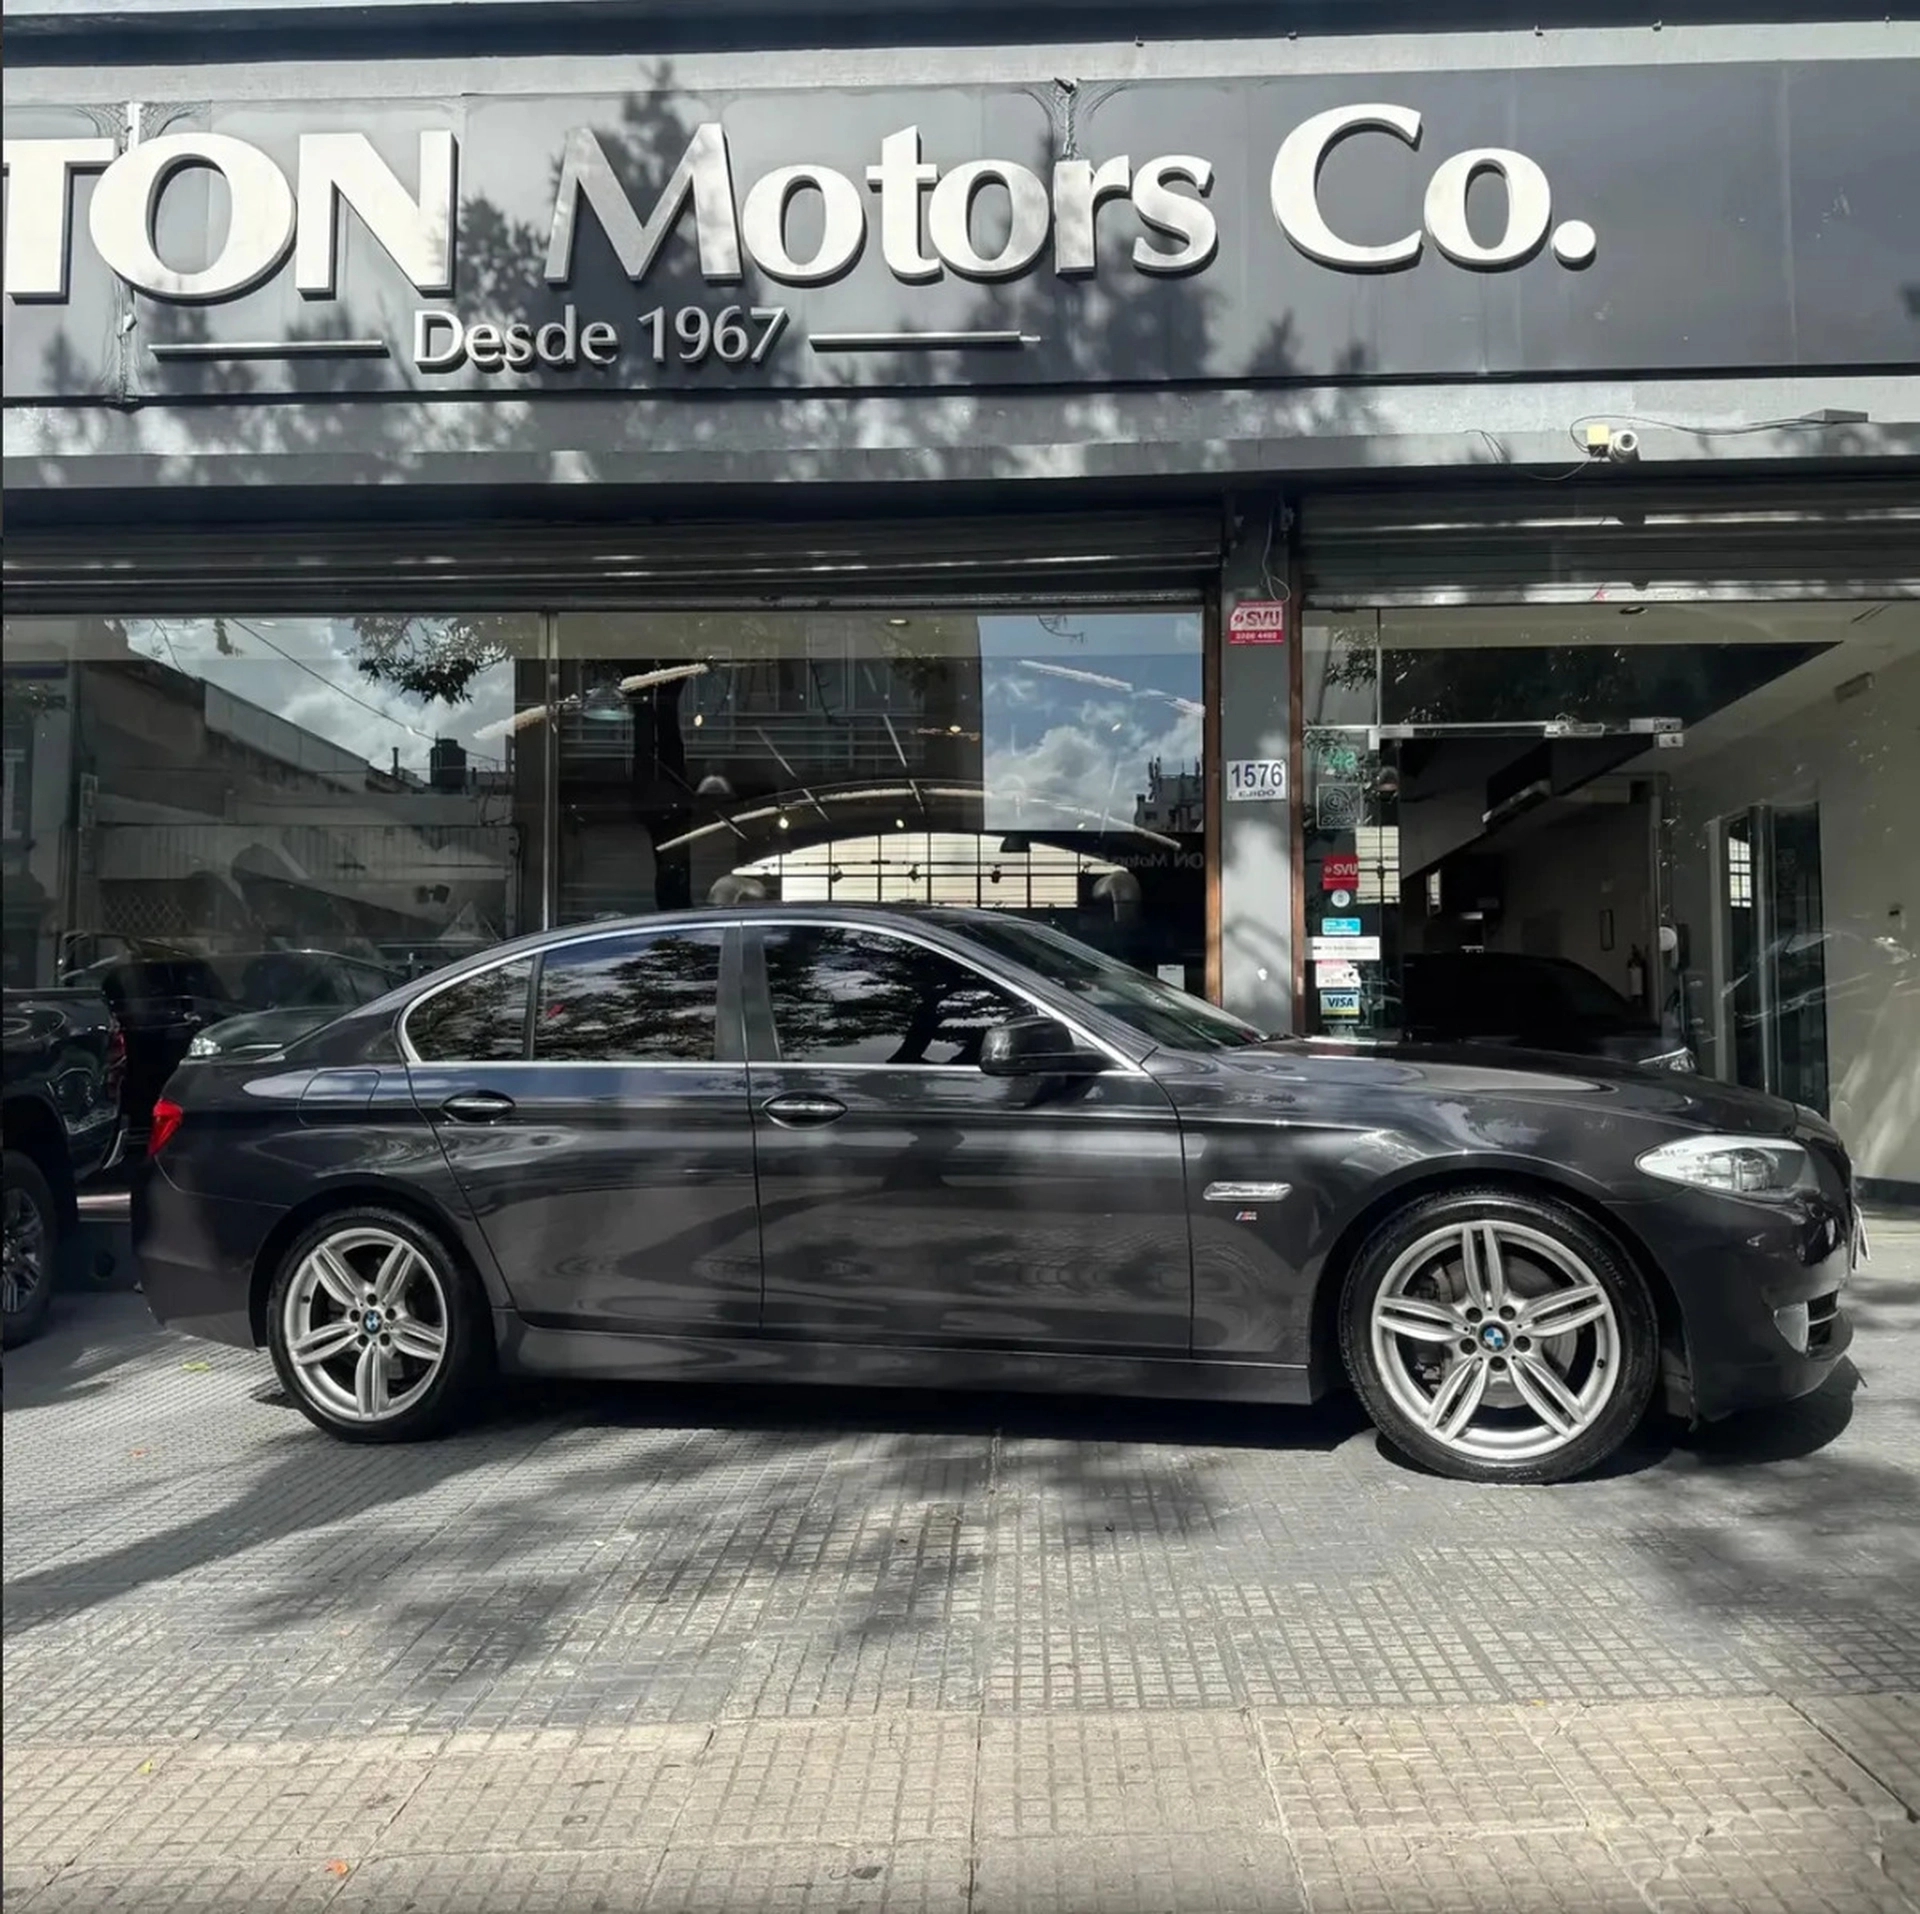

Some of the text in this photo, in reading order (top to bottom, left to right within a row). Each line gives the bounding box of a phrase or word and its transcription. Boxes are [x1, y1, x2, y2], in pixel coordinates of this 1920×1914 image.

[545, 122, 1217, 284] Motors
[1270, 103, 1597, 273] Co.
[413, 305, 788, 373] Desde 1967
[1246, 610, 1280, 627] SVU
[1231, 762, 1283, 788] 1576
[1333, 863, 1358, 876] SVU
[1327, 997, 1354, 1008] VISA
